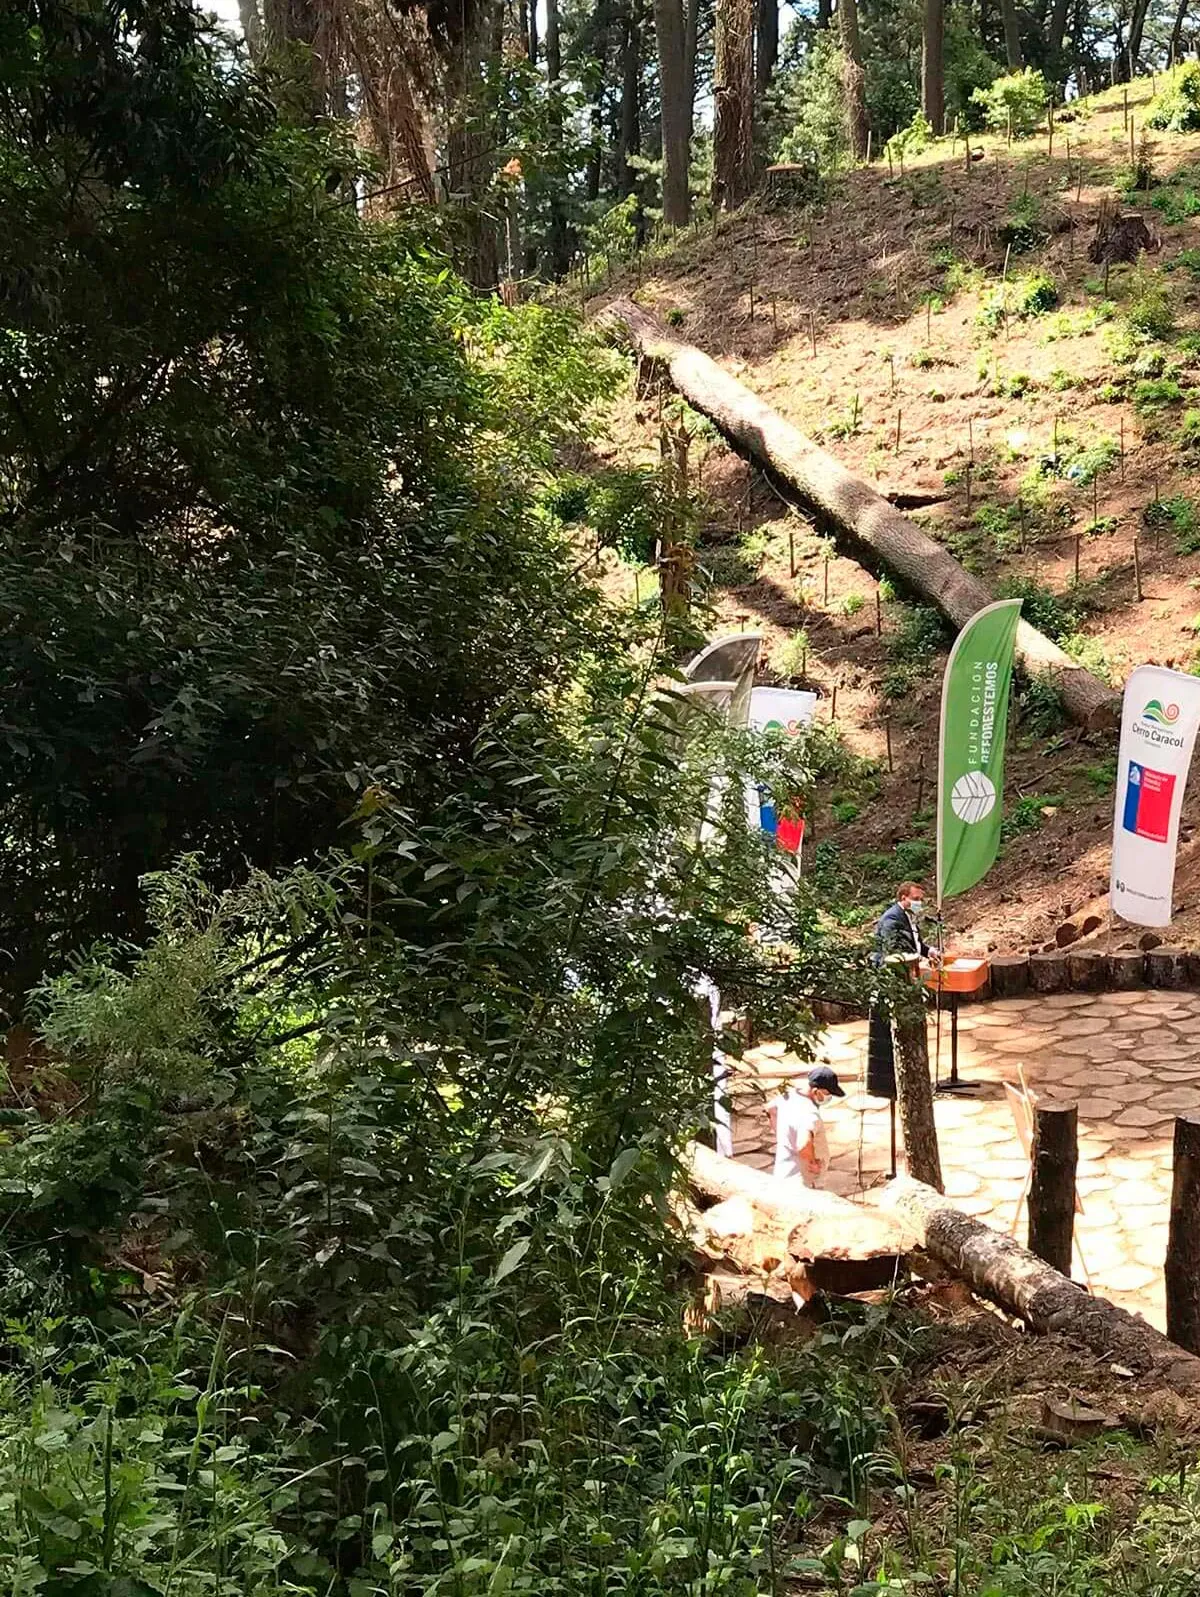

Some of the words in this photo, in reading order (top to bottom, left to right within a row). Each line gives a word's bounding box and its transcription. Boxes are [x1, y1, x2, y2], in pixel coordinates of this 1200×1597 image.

[968, 661, 984, 764] FUNDACION
[1132, 722, 1150, 738] Cerro
[1151, 730, 1185, 748] Caracol
